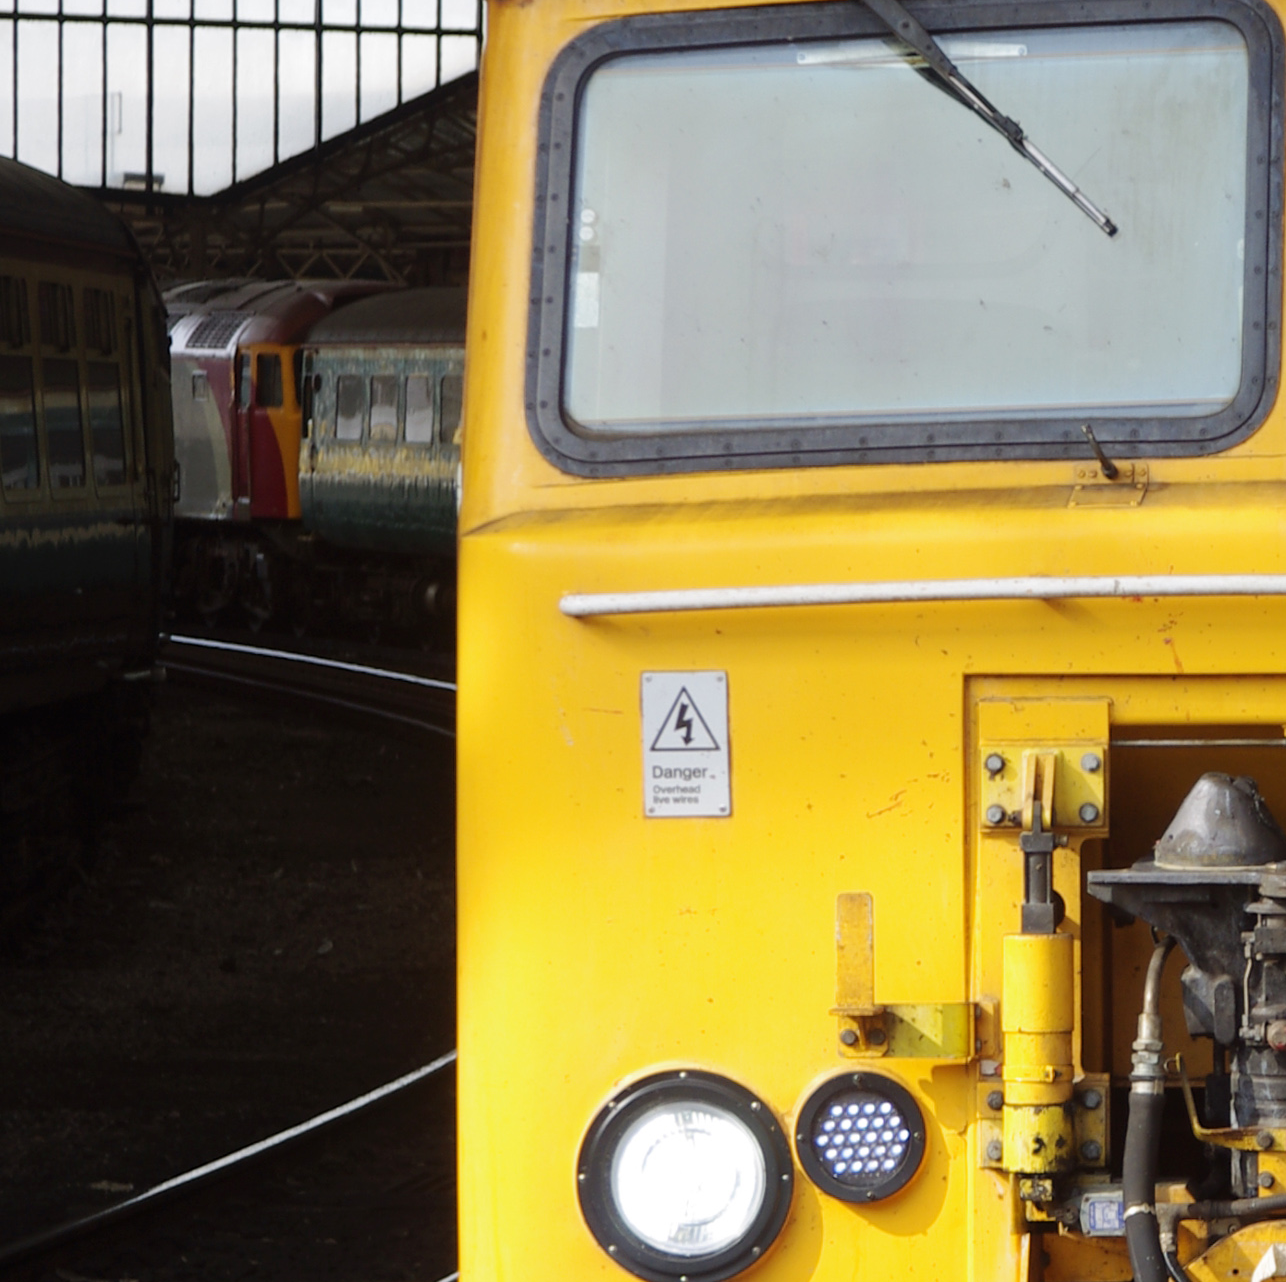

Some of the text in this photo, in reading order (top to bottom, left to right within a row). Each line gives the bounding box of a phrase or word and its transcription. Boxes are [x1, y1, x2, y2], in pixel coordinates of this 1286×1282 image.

[652, 765, 708, 781] Danger
[653, 784, 701, 794] Overhead
[653, 795, 699, 804] live wires
